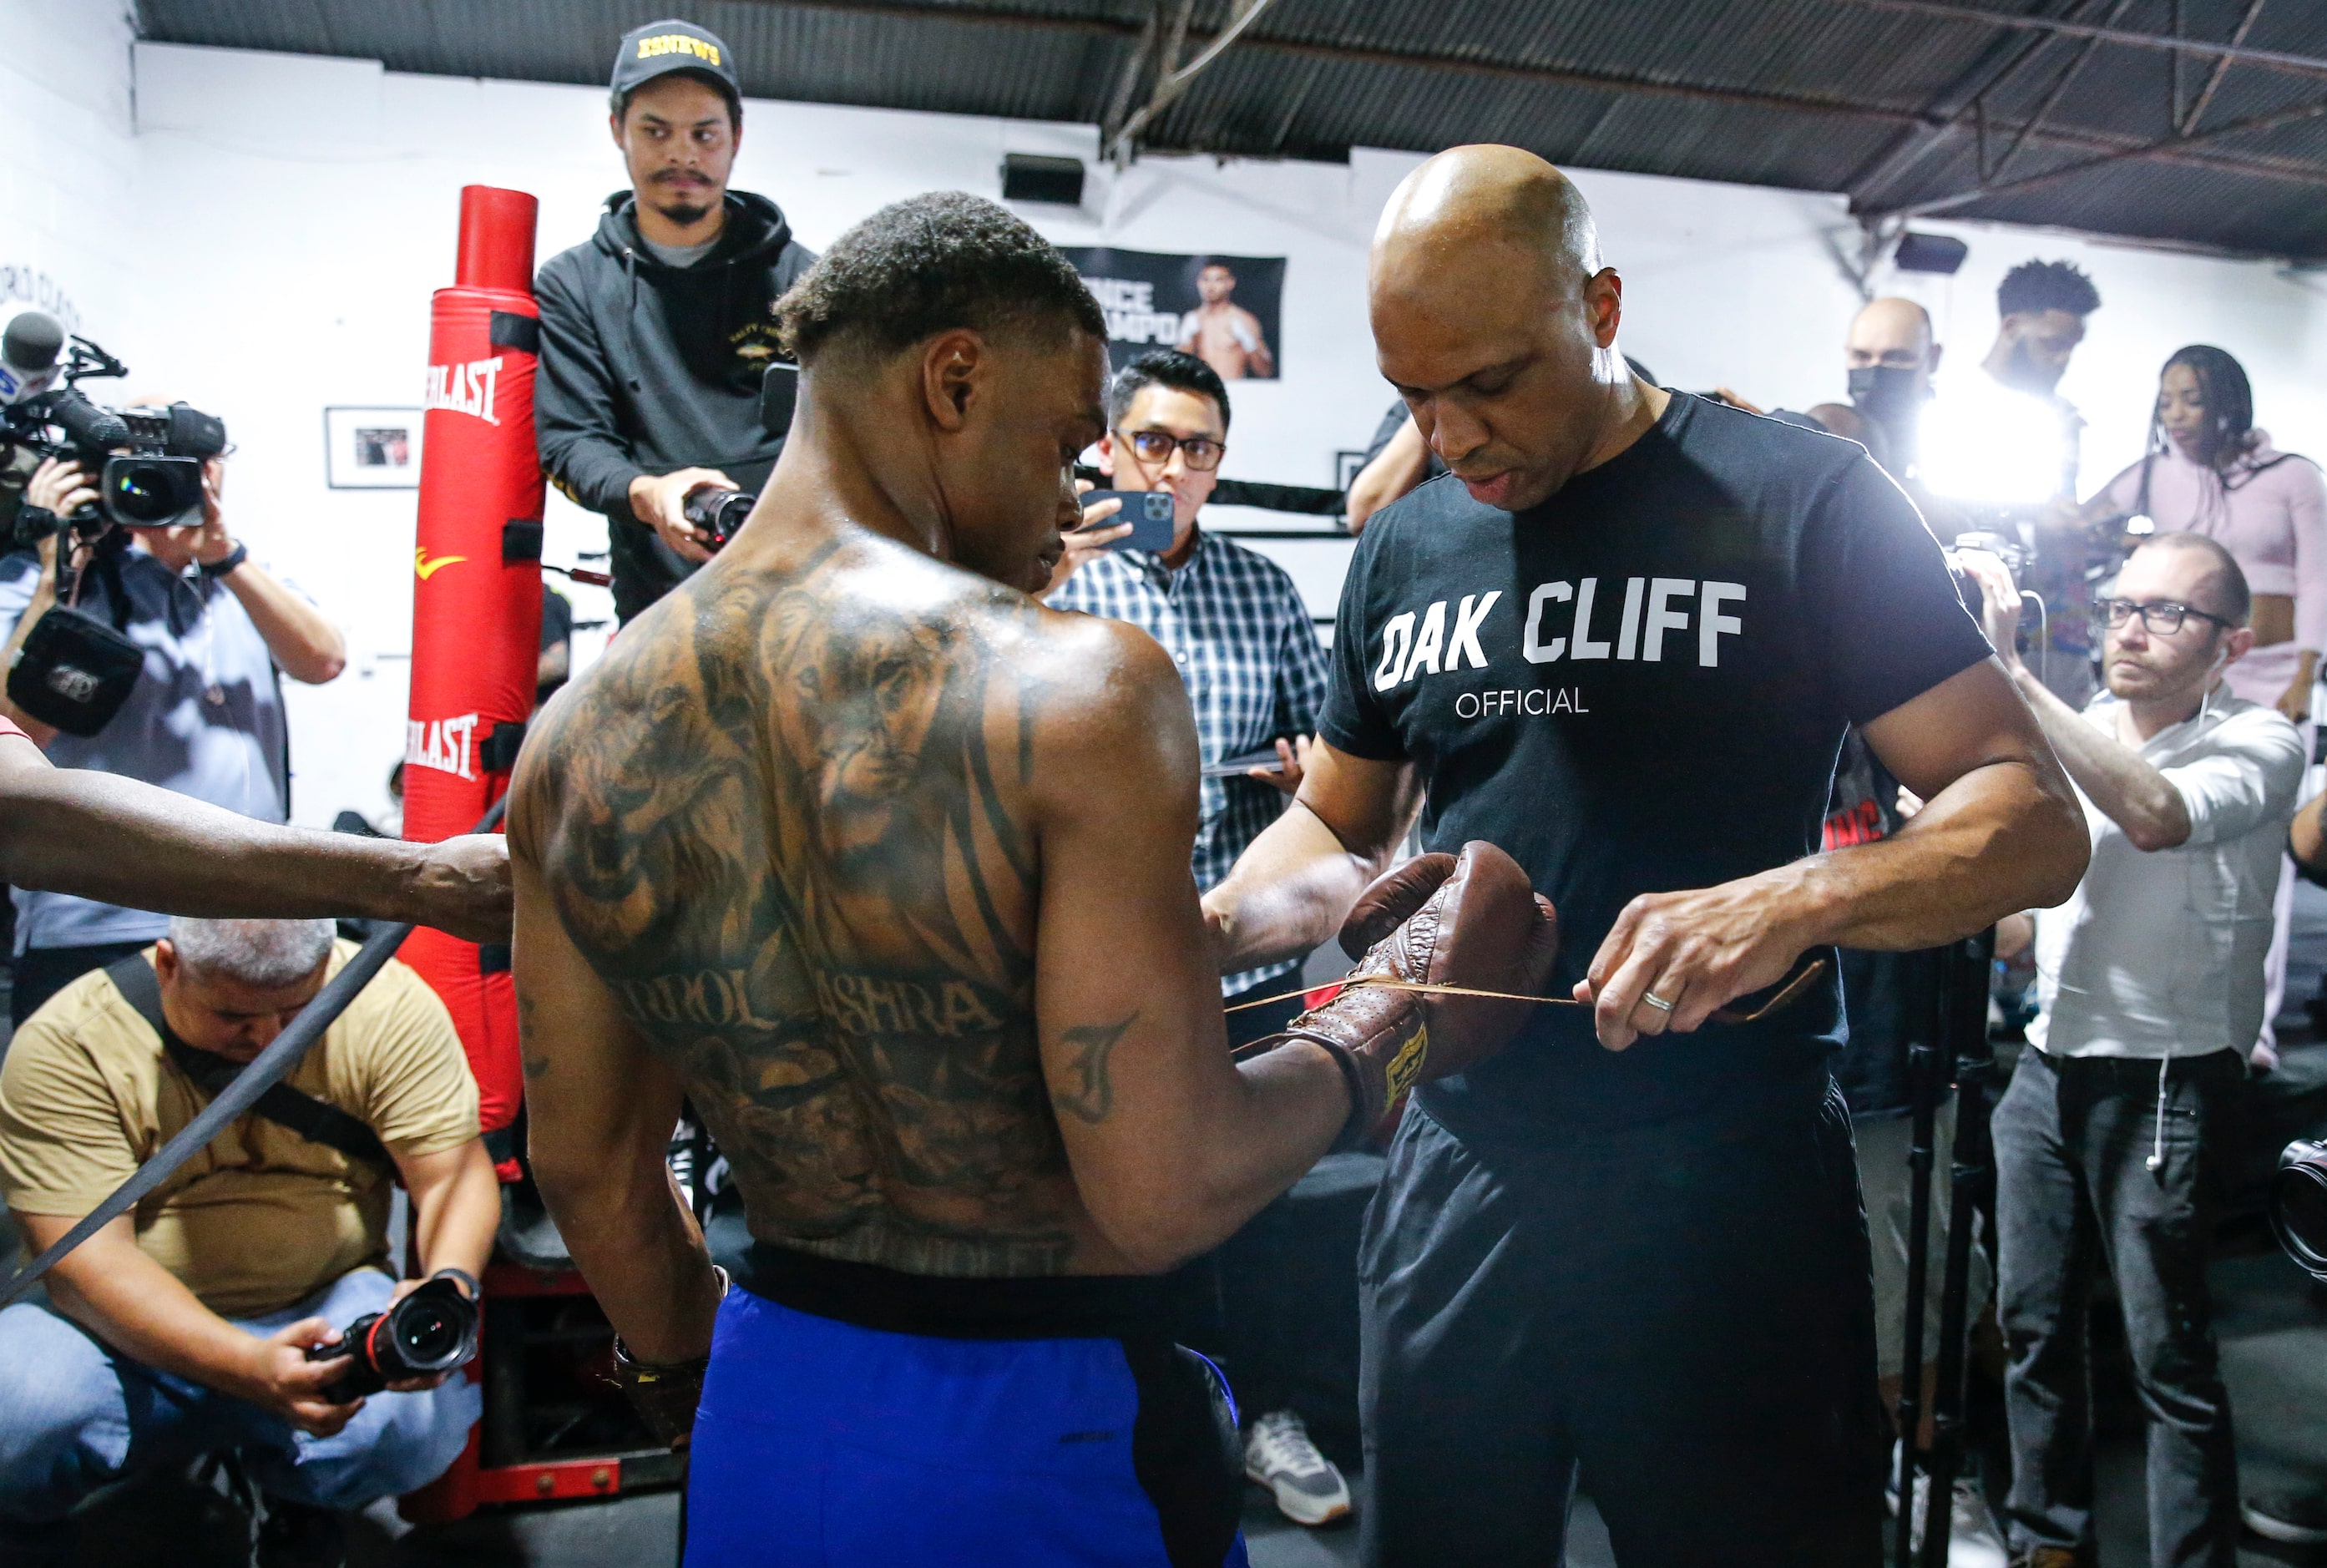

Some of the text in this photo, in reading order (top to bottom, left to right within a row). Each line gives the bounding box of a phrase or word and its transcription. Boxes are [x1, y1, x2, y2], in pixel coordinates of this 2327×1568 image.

[637, 33, 722, 67] ESNEWS
[1374, 576, 1748, 693] OAK CLIFF
[1454, 686, 1590, 719] OFFICIAL
